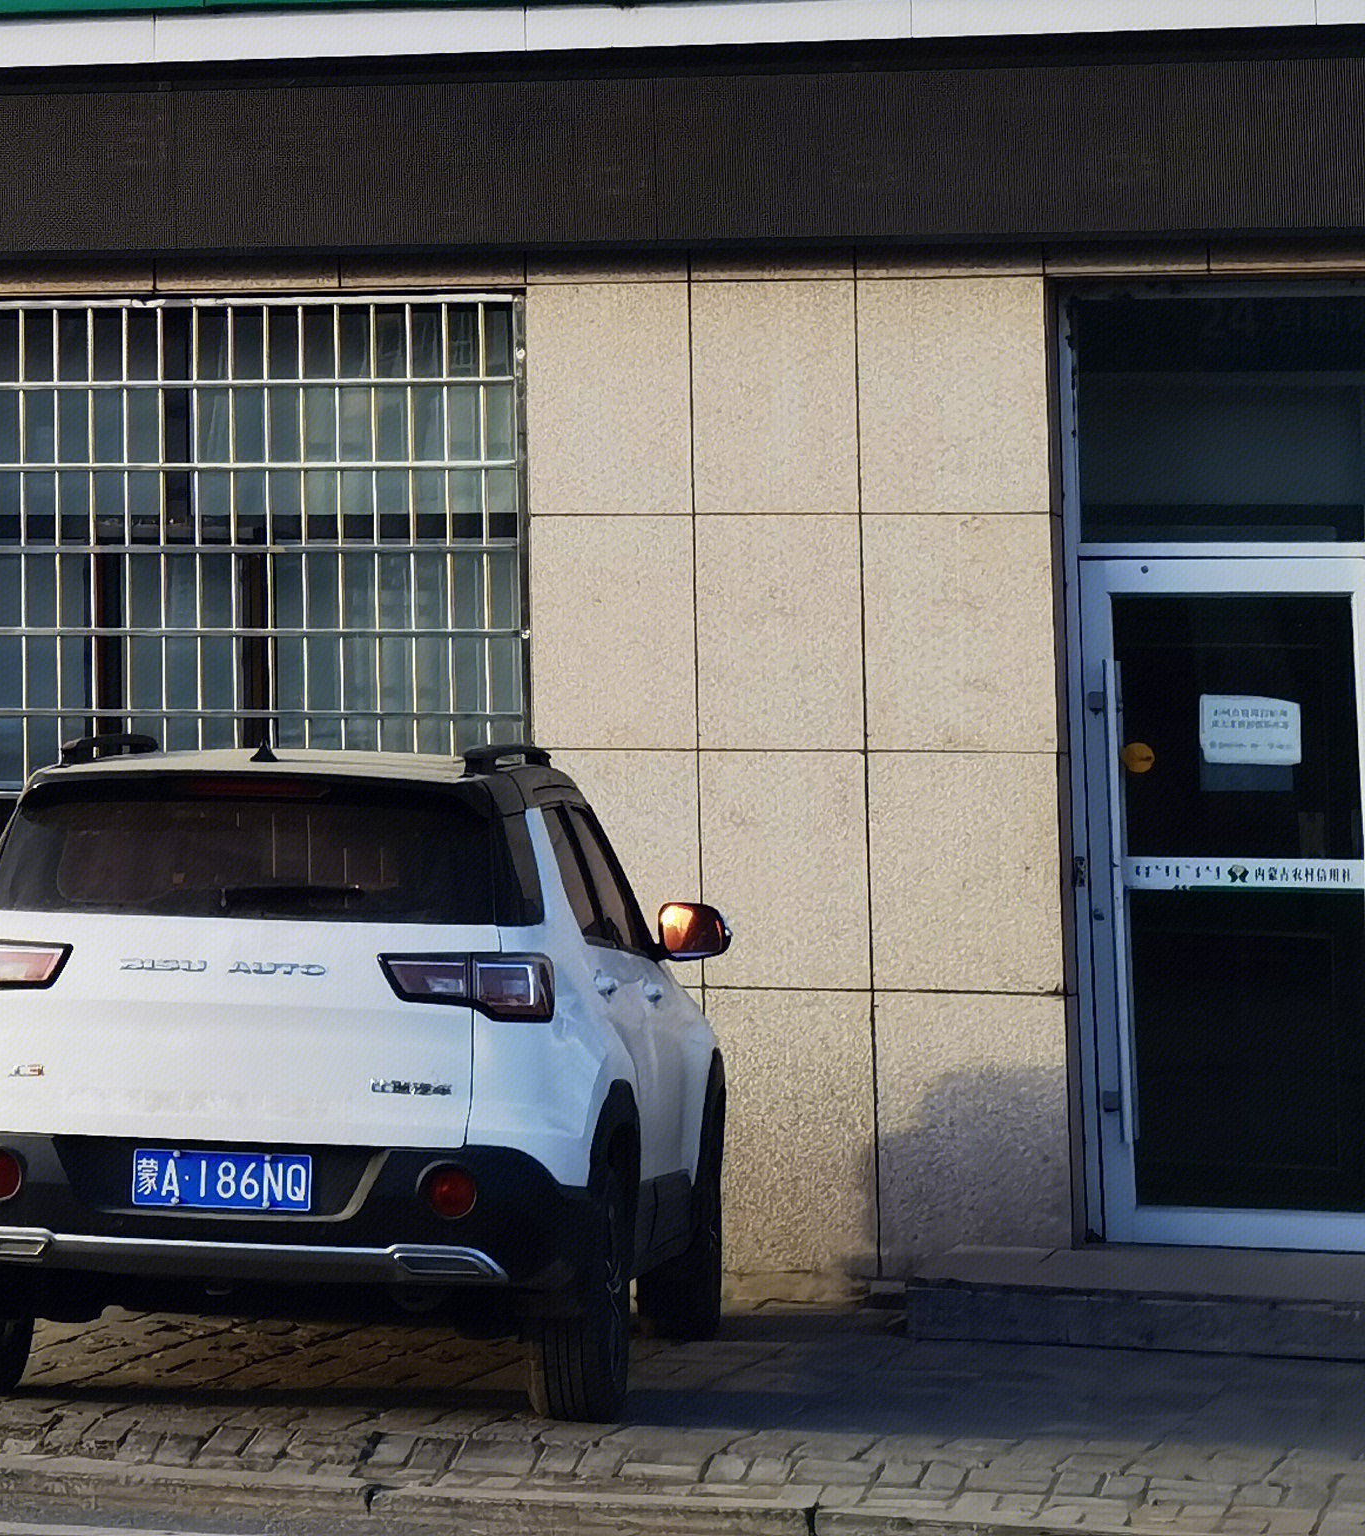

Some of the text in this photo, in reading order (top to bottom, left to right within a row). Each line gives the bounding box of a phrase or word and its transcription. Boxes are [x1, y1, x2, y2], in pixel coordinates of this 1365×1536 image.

[1254, 866, 1352, 883] 内蒙古农村信用社
[120, 958, 327, 976] BISU AUTO
